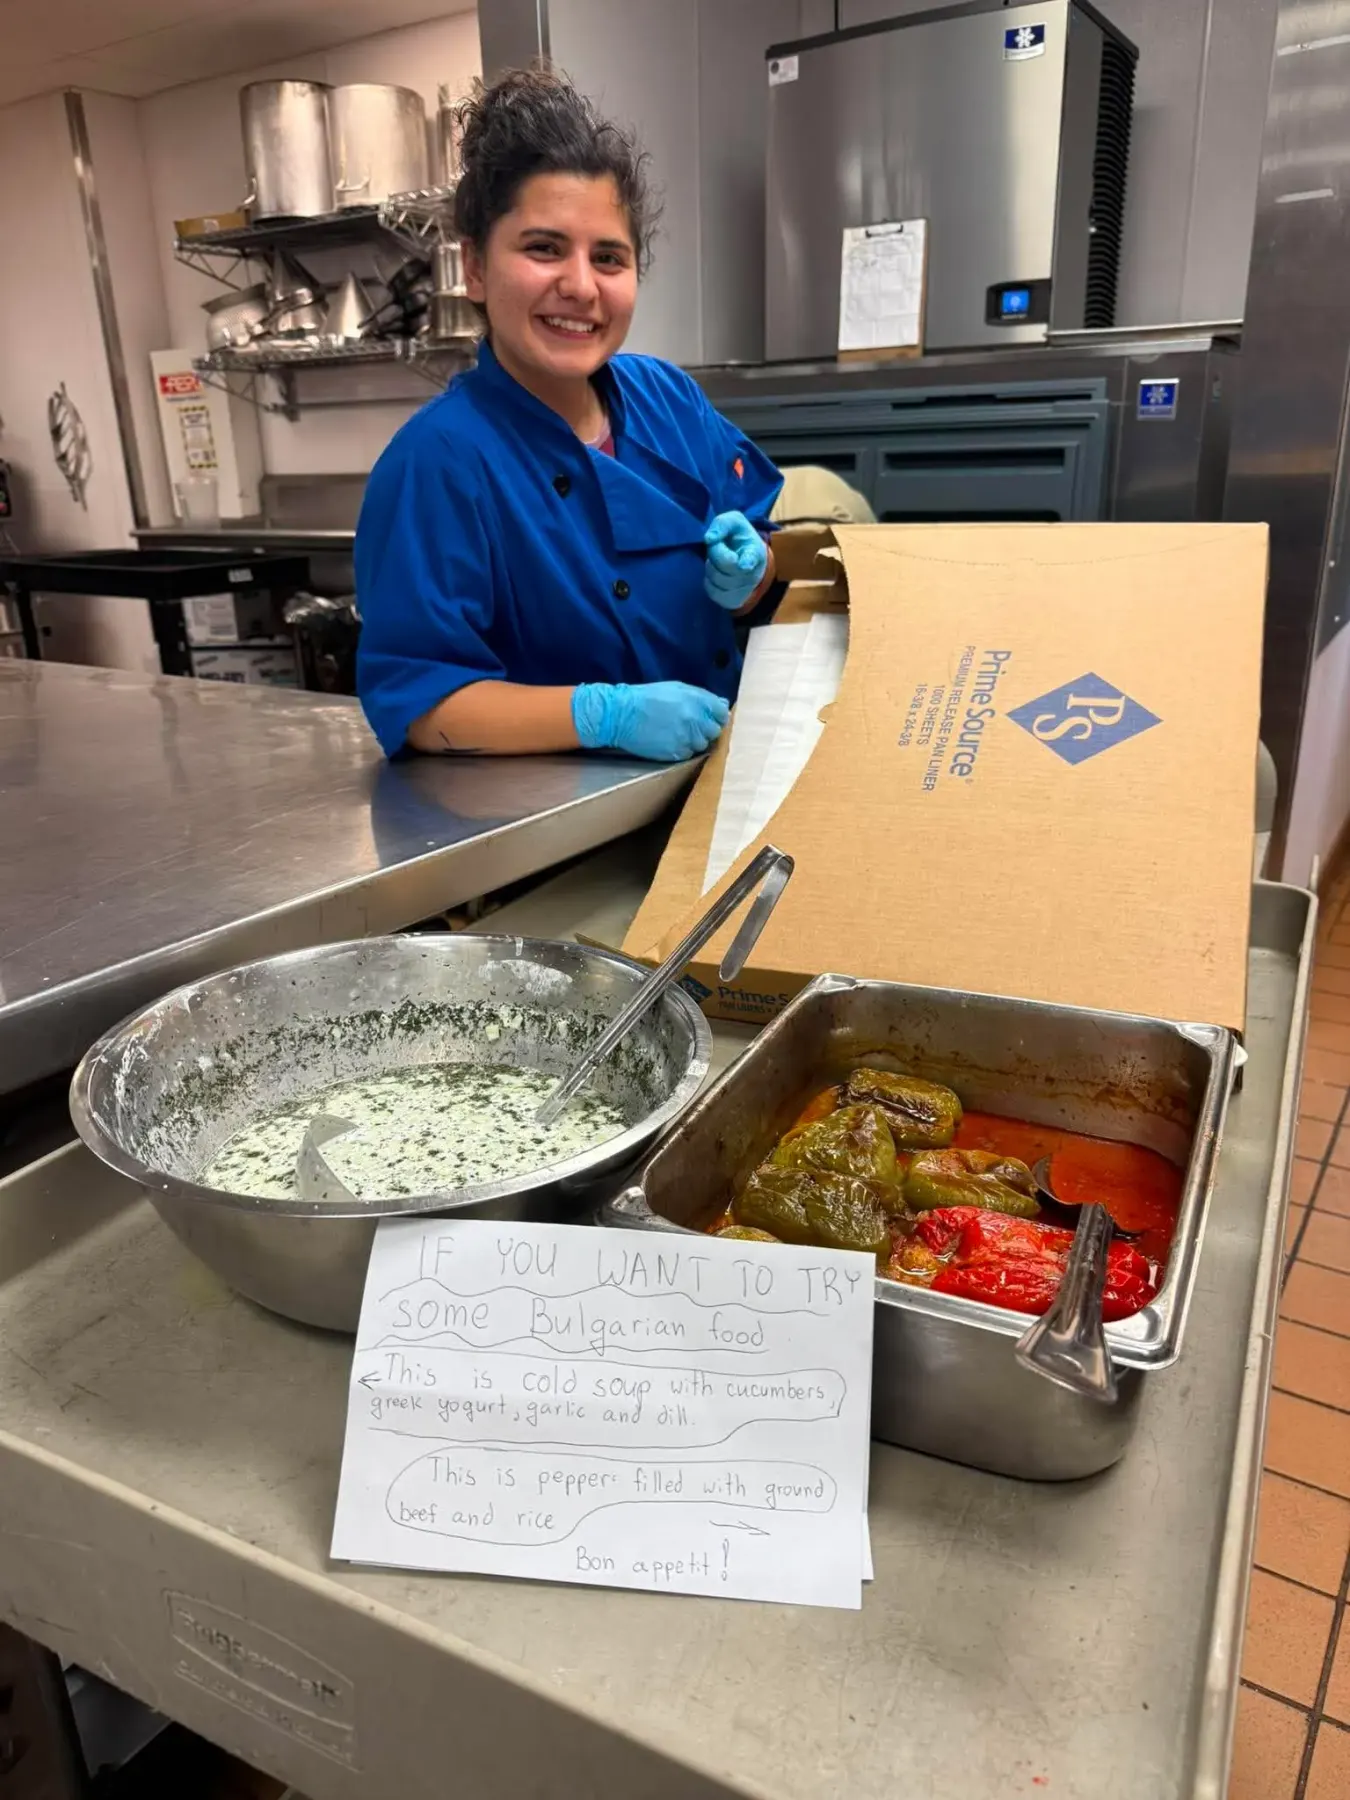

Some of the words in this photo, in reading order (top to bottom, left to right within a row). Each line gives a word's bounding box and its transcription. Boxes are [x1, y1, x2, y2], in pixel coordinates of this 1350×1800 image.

[954, 645, 976, 688] PREMIUM
[971, 650, 1012, 705] Prime
[910, 683, 928, 710] 16-3/8
[929, 684, 945, 706] 1000
[939, 690, 963, 734] RELEASE
[898, 718, 916, 747] 24-3/8
[916, 707, 938, 745] SHEETS
[1033, 693, 1126, 741] PS
[931, 736, 950, 758] PAN
[950, 708, 995, 777] Source
[922, 759, 942, 791] LINER
[718, 986, 776, 1004] Prime
[420, 1236, 454, 1280] IF
[497, 1238, 557, 1277] YOU
[597, 1249, 711, 1292] WANT
[732, 1260, 773, 1298] TO
[798, 1267, 861, 1305] TRY
[530, 1297, 685, 1356] Bulgarian
[708, 1311, 763, 1347] food
[385, 1353, 437, 1386] This
[473, 1368, 493, 1389] is
[523, 1365, 577, 1394] cold
[592, 1377, 651, 1407] soup
[670, 1369, 713, 1397] with
[370, 1395, 422, 1420] greek
[526, 1401, 585, 1427] garlic
[603, 1405, 642, 1424] and
[427, 1456, 476, 1487] This
[496, 1468, 516, 1487] is
[633, 1467, 683, 1494] filled
[703, 1472, 746, 1496] with
[765, 1480, 824, 1510] ground
[400, 1501, 438, 1523] beef
[451, 1501, 494, 1526] and
[517, 1510, 555, 1530] rice
[576, 1545, 615, 1571] Bon
